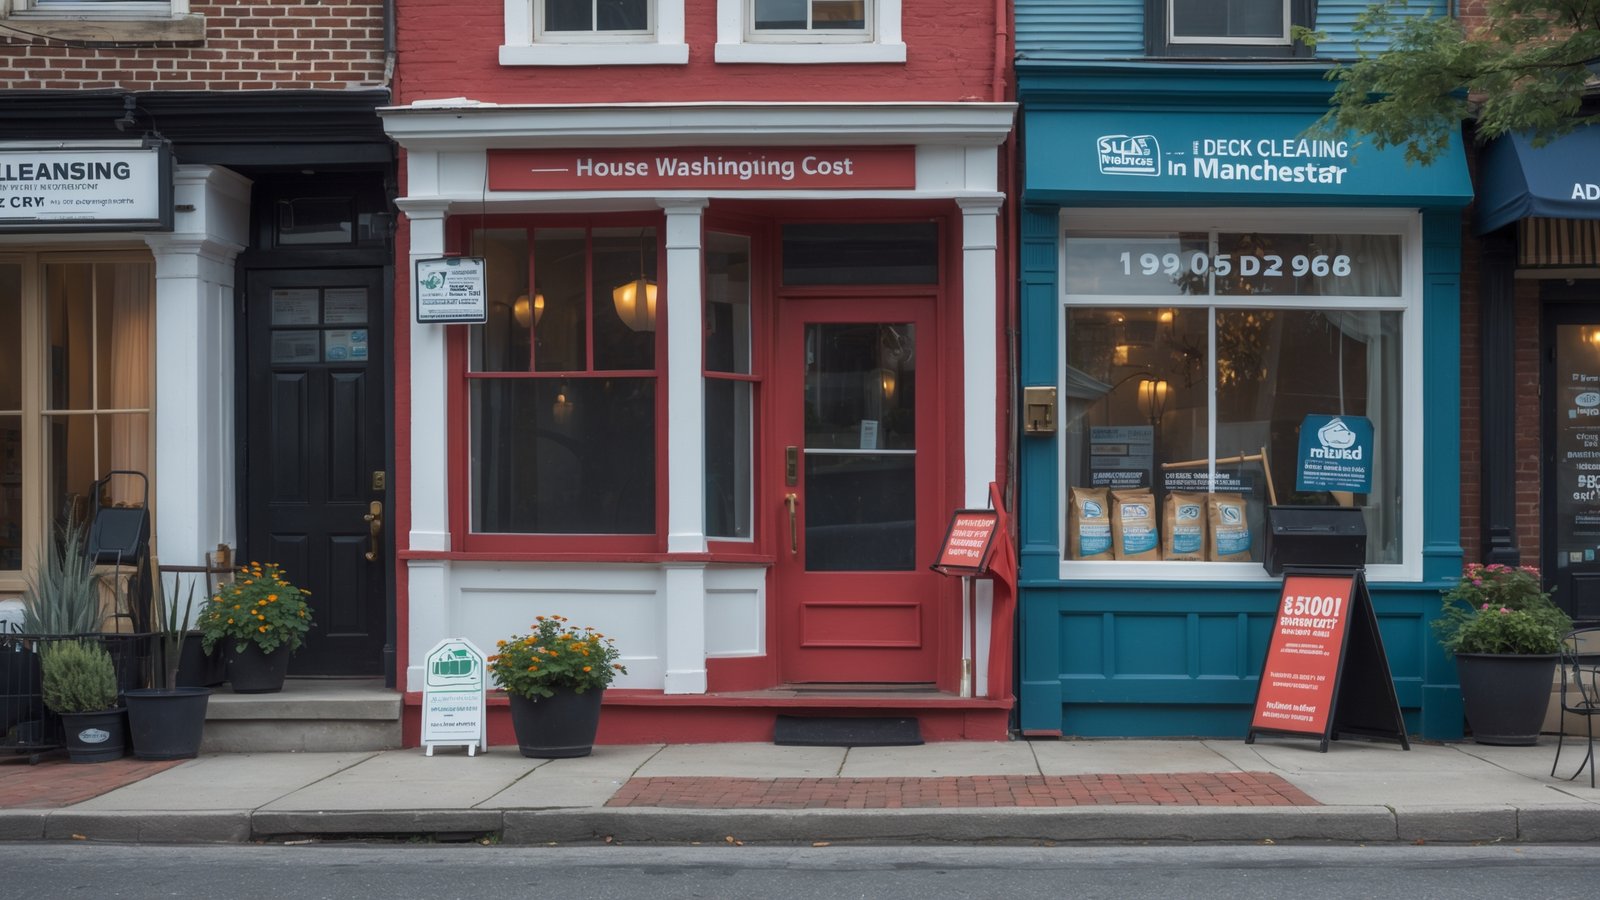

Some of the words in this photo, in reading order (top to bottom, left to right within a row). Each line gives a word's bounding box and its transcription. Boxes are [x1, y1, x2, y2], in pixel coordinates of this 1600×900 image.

[1204, 139, 1252, 157] DECK
[576, 158, 649, 177] House
[801, 156, 853, 177] Cost
[1571, 183, 1600, 201] AD
[1240, 255, 1283, 277] D2
[1291, 255, 1351, 277] 968
